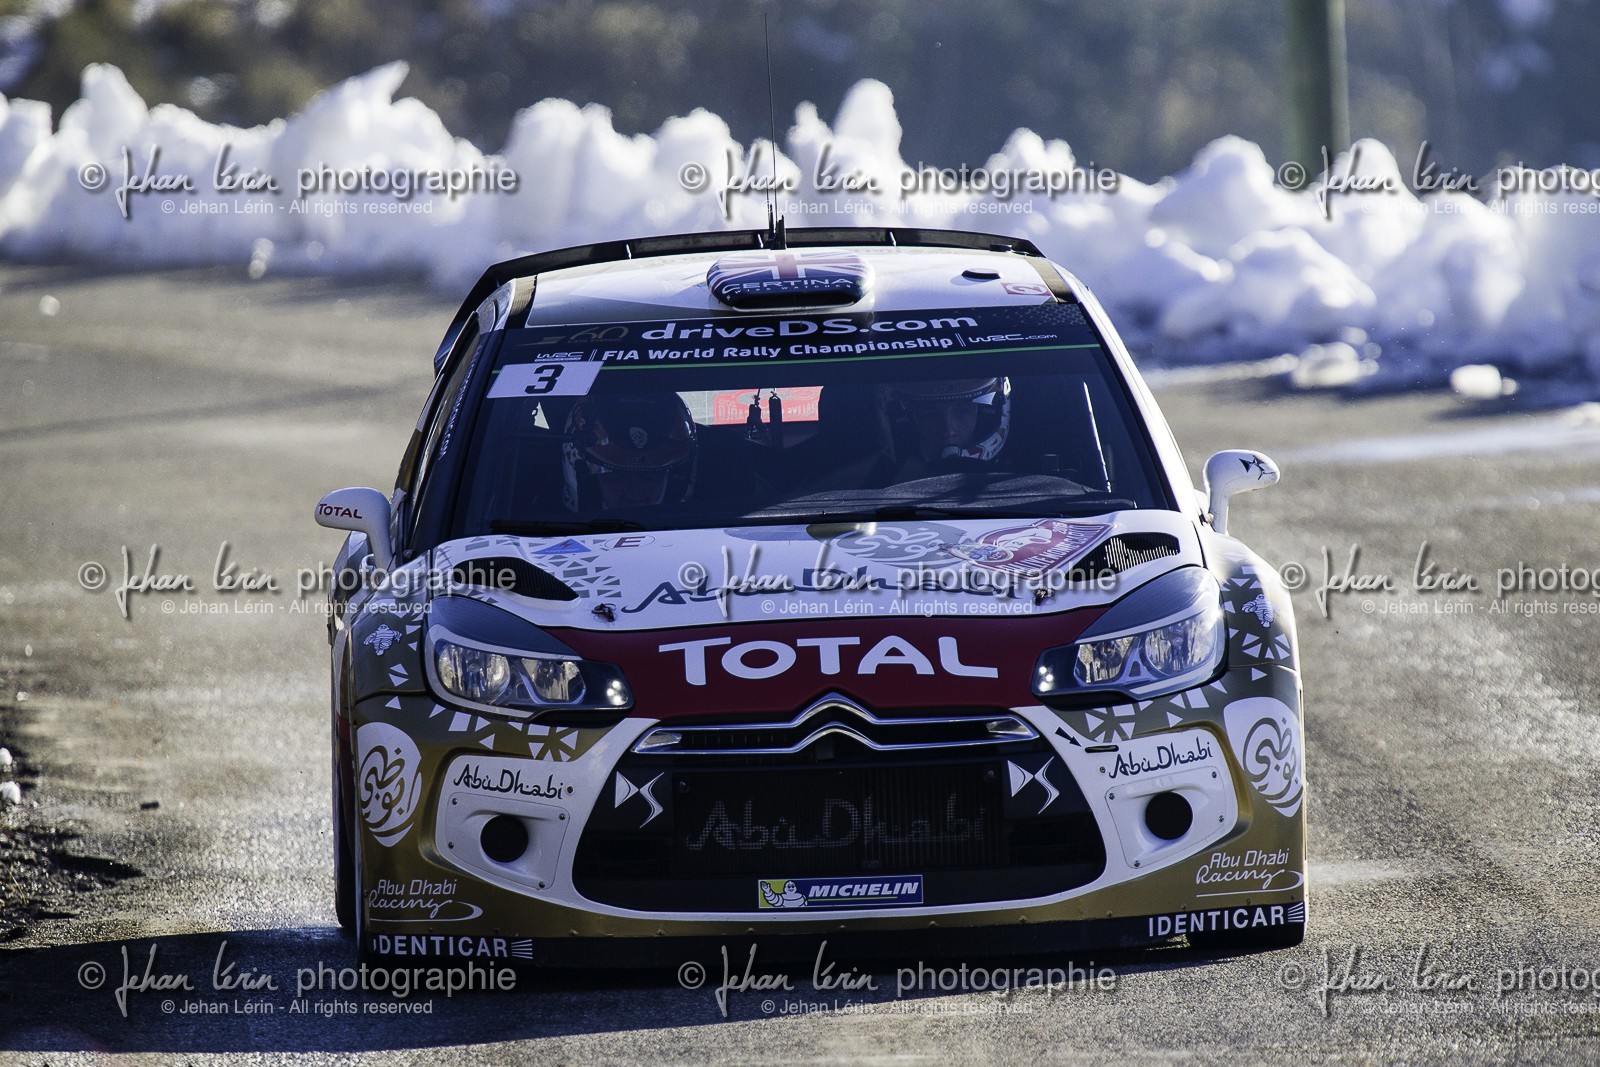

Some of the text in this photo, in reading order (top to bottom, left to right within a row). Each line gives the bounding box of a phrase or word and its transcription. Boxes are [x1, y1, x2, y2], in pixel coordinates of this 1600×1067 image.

[721, 278, 854, 294] CERTINA
[641, 317, 979, 340] driveDS.com
[602, 349, 640, 361] FIA
[648, 347, 715, 360] World
[723, 346, 782, 359] Rally
[789, 335, 953, 355] Championship
[524, 364, 565, 395] 3
[318, 503, 363, 520] TOTAL
[613, 536, 646, 549] E
[658, 635, 999, 686] TOTAL
[1209, 848, 1290, 869] Abu Dhabi
[377, 878, 458, 895] Abu Dhabi
[1195, 865, 1286, 889] Racing
[808, 881, 919, 898] MICHELIN
[368, 889, 453, 919] Racing
[1149, 905, 1285, 937] IDENTICAR
